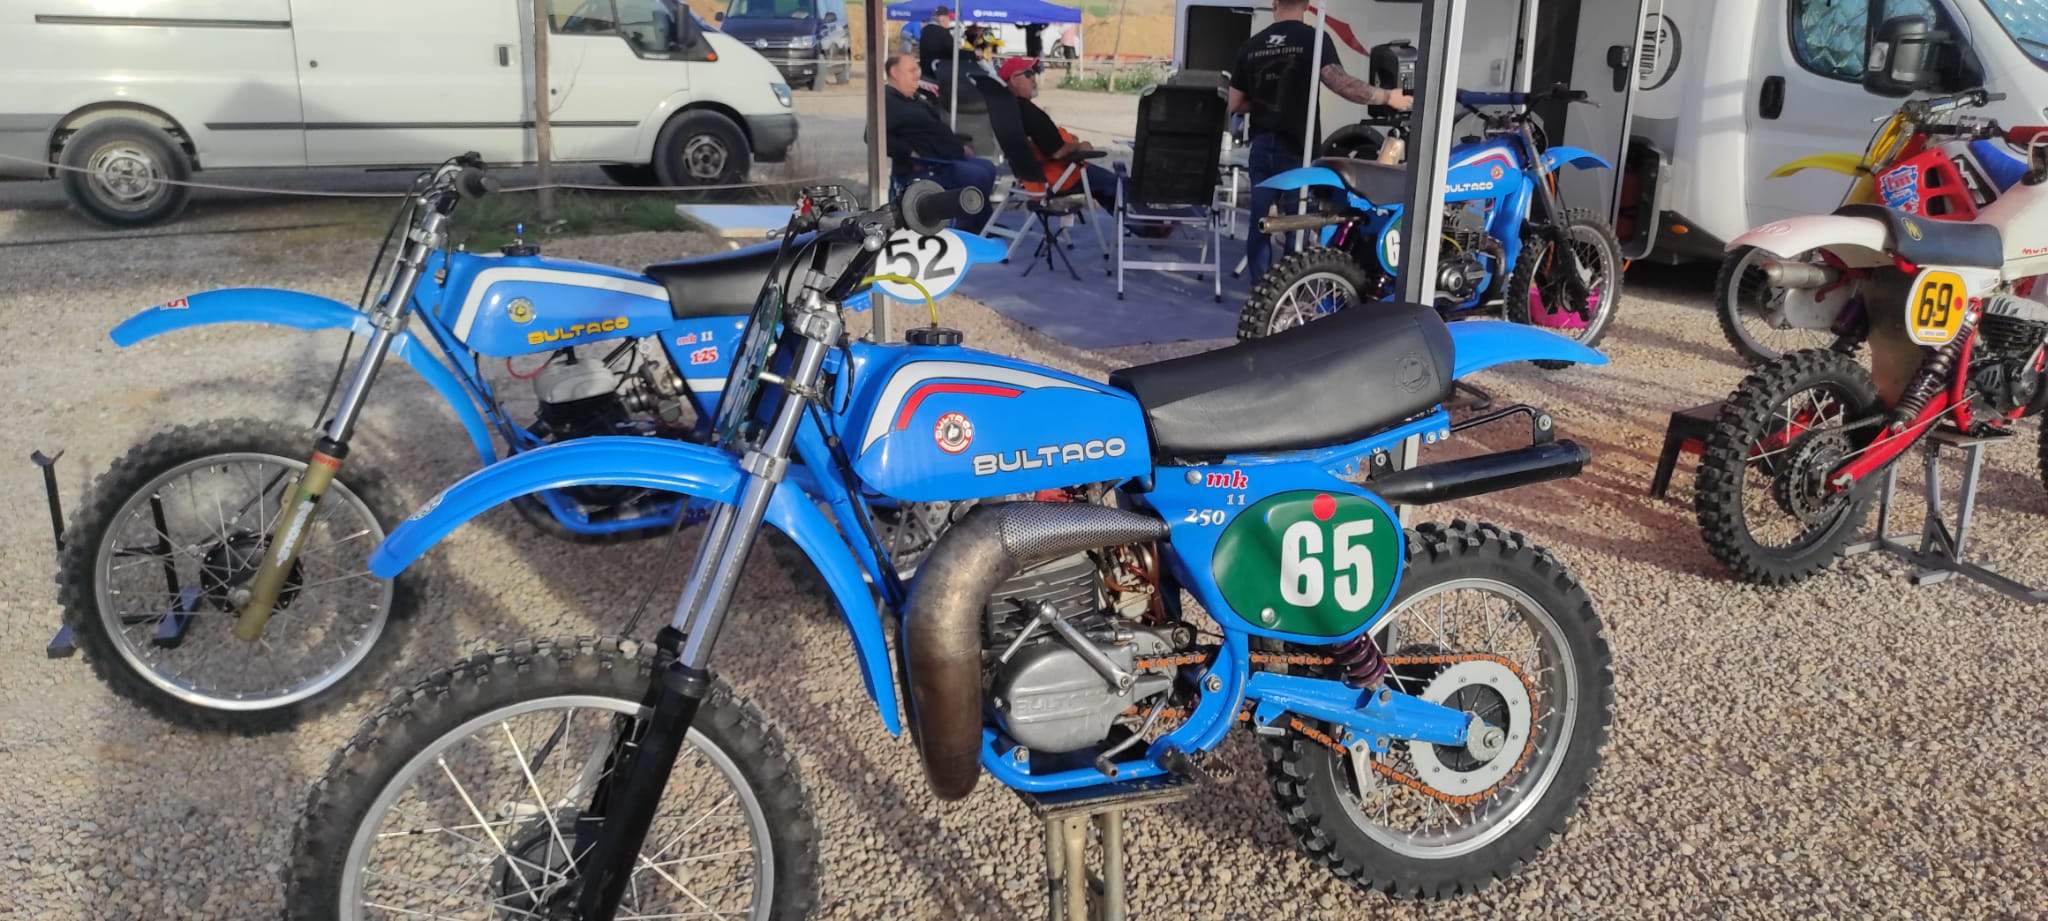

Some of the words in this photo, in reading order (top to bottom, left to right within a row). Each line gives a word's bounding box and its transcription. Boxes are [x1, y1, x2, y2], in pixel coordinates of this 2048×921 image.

[884, 235, 956, 285] 52
[1917, 281, 1954, 328] 69
[527, 315, 629, 345] BULTACO
[690, 346, 719, 365] 125
[973, 437, 1126, 476] BULTACO
[1206, 469, 1248, 490] mk
[1183, 508, 1226, 526] 250
[1279, 518, 1375, 613] 65
